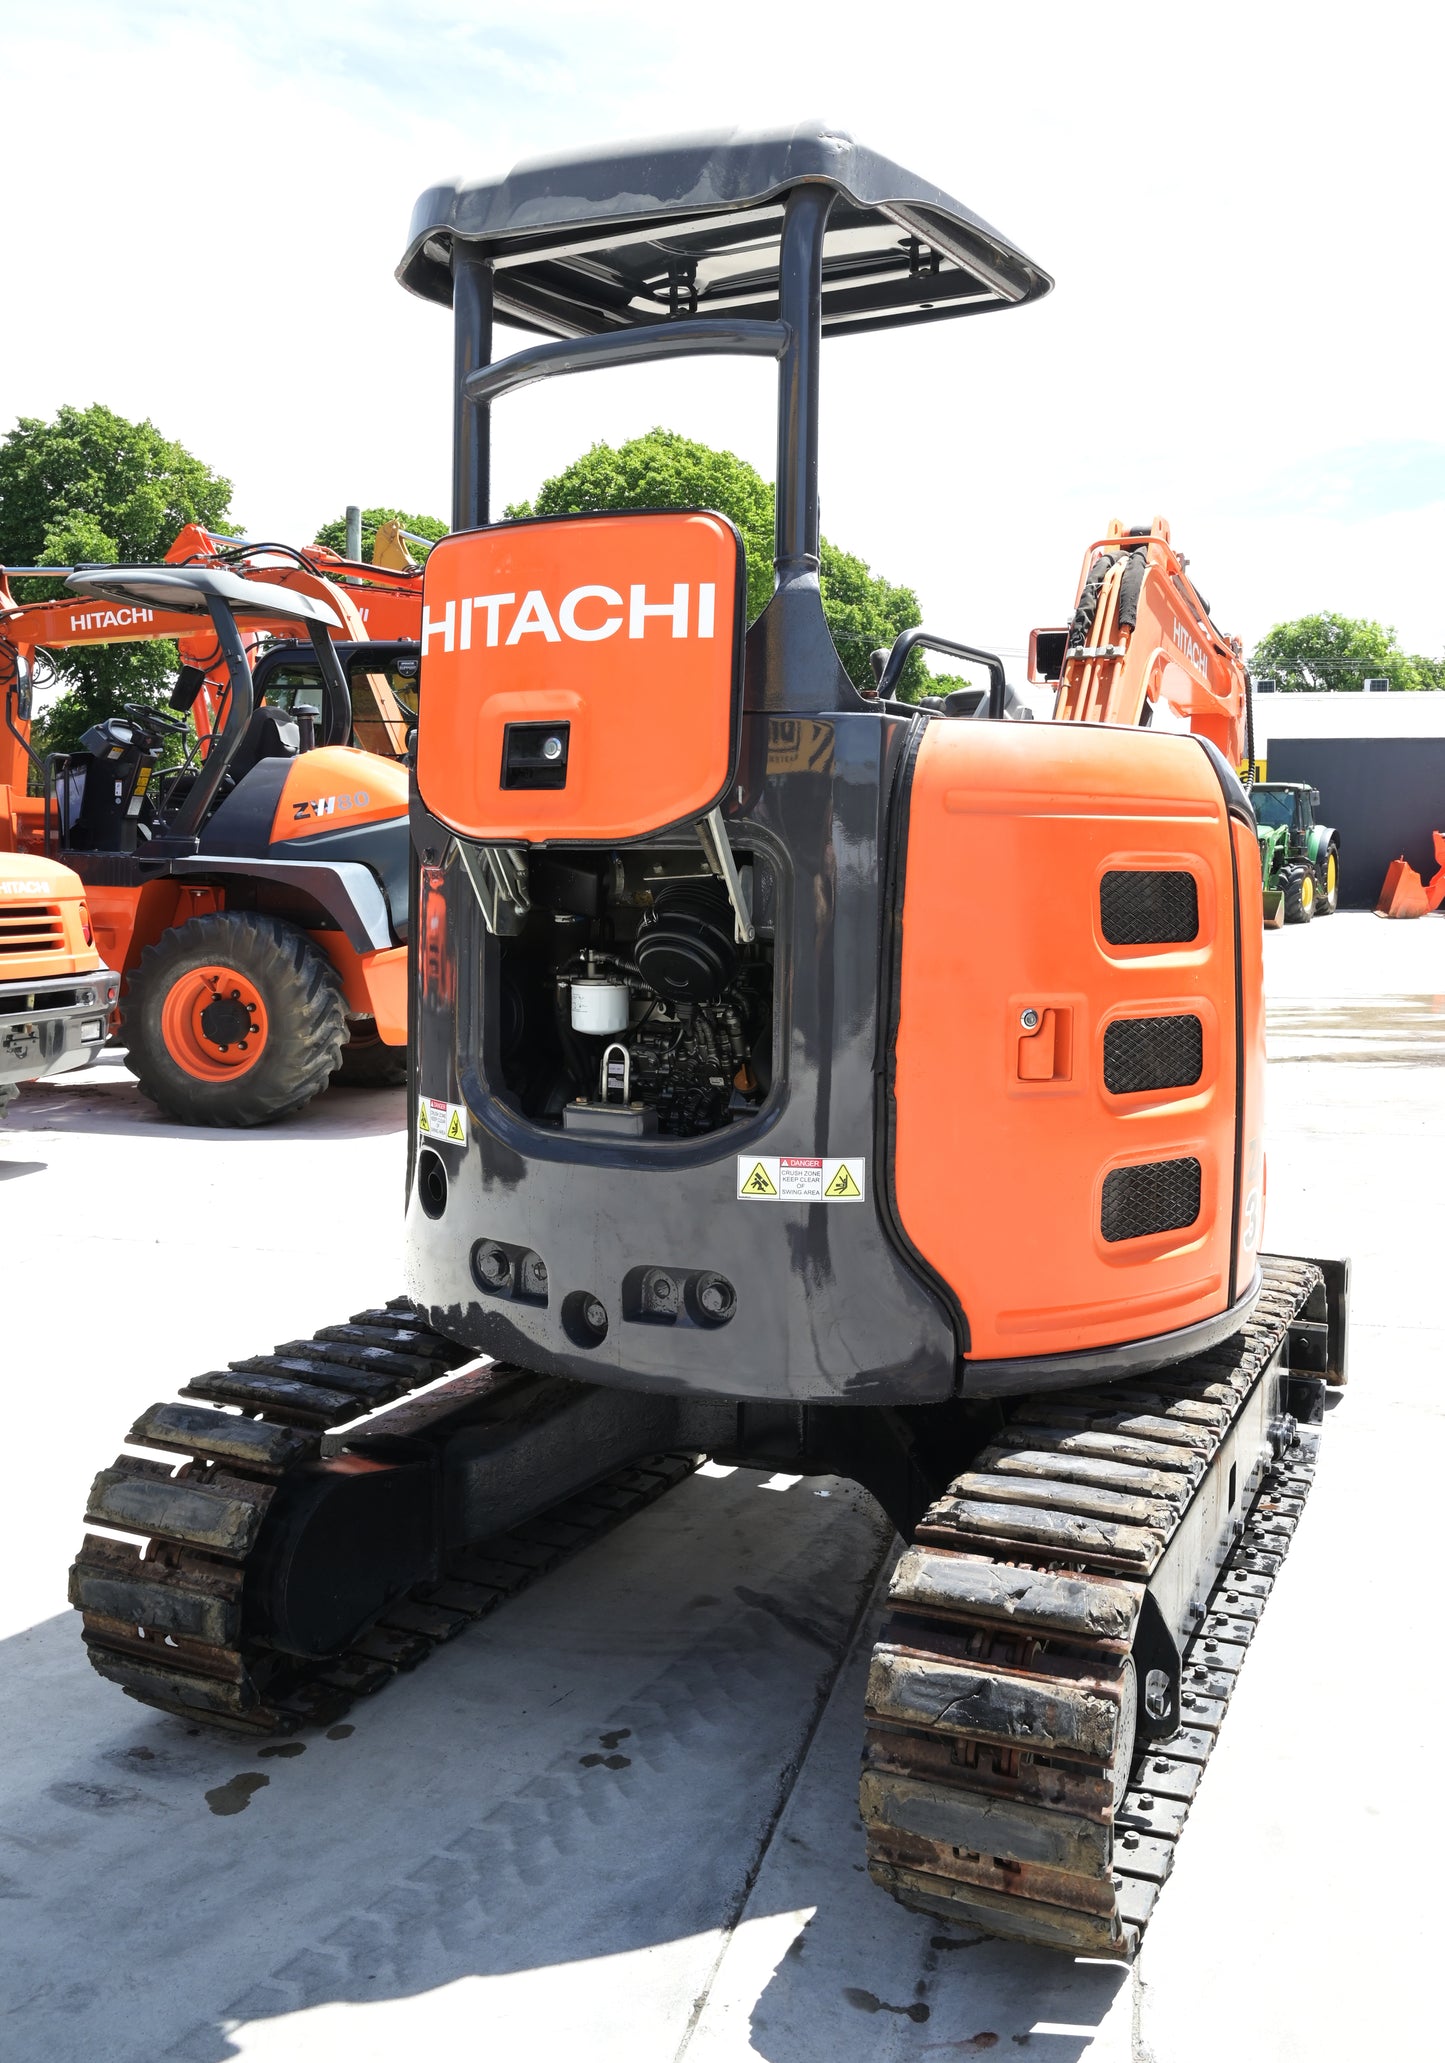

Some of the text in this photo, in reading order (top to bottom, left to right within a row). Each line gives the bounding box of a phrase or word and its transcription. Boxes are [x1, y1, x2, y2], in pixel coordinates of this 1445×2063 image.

[70, 608, 154, 632] HITACHI
[421, 583, 716, 657] HITACHI
[1173, 616, 1208, 679] HITACHI
[292, 791, 370, 821] ZW80
